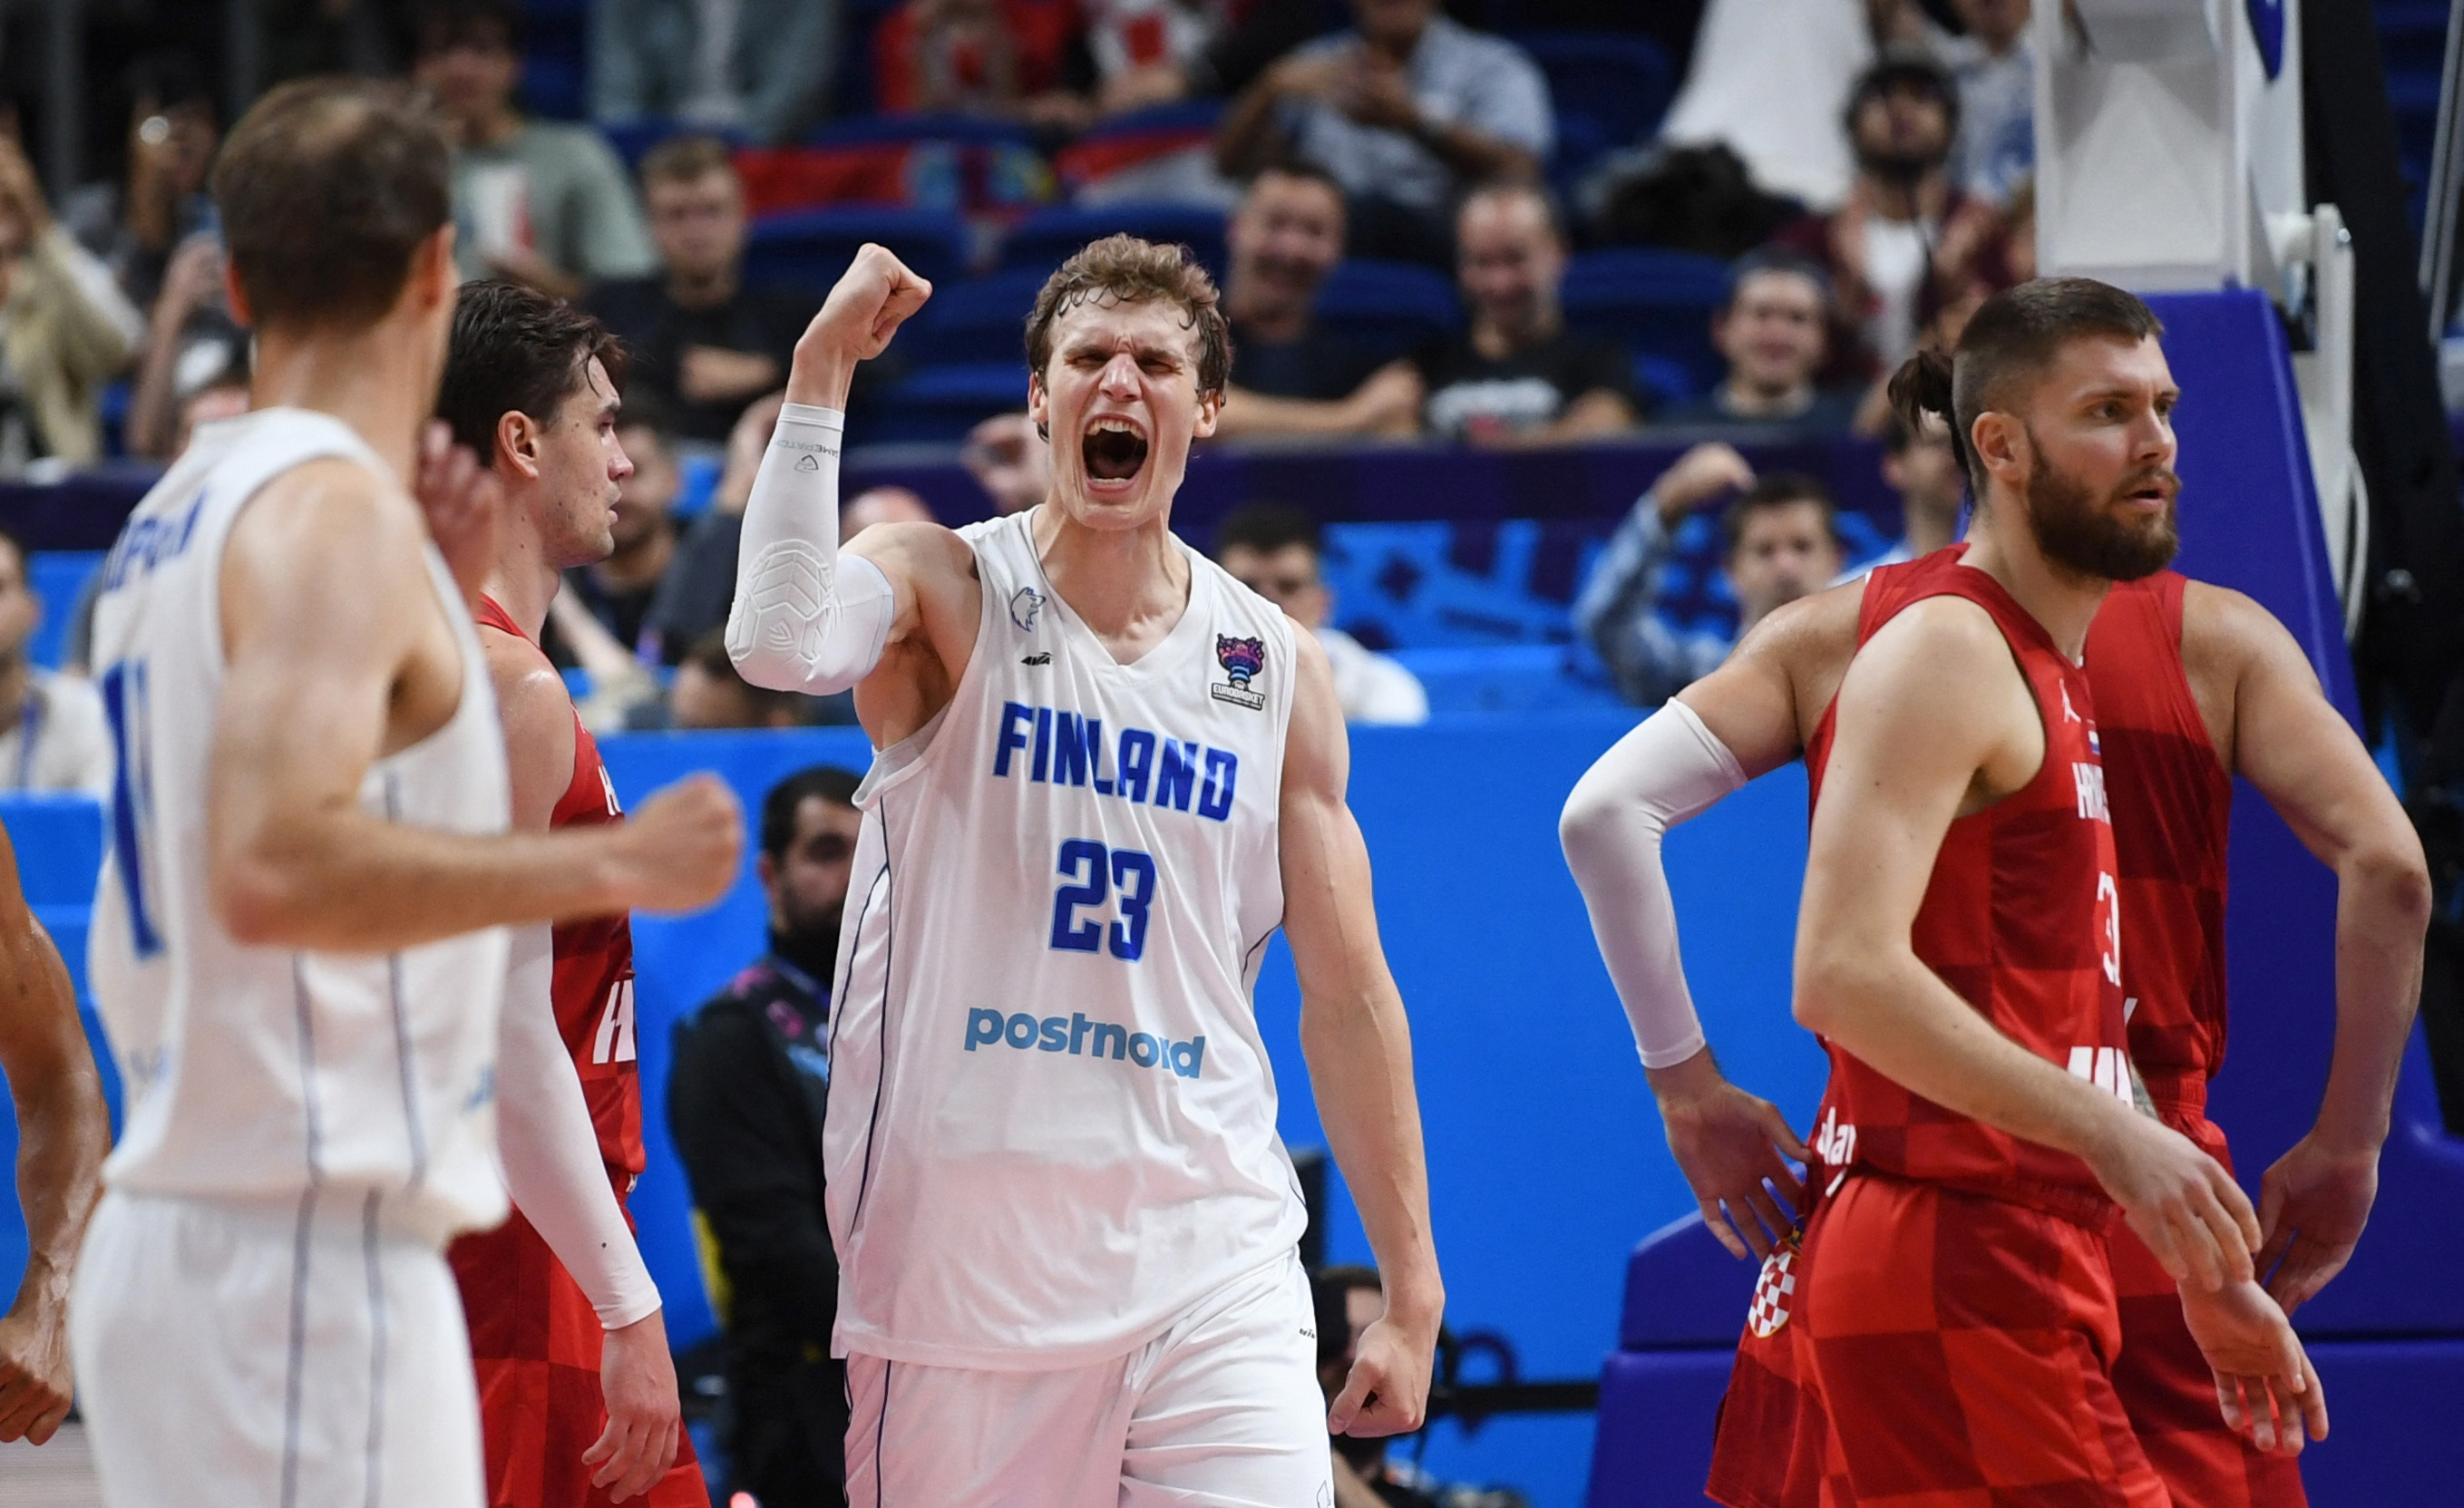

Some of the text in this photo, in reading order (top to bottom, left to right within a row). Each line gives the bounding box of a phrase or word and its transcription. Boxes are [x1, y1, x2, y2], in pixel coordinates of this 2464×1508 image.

[991, 699, 1239, 823] FINLAND
[1048, 838, 1158, 963] 23
[963, 1005, 1207, 1080] postnord
